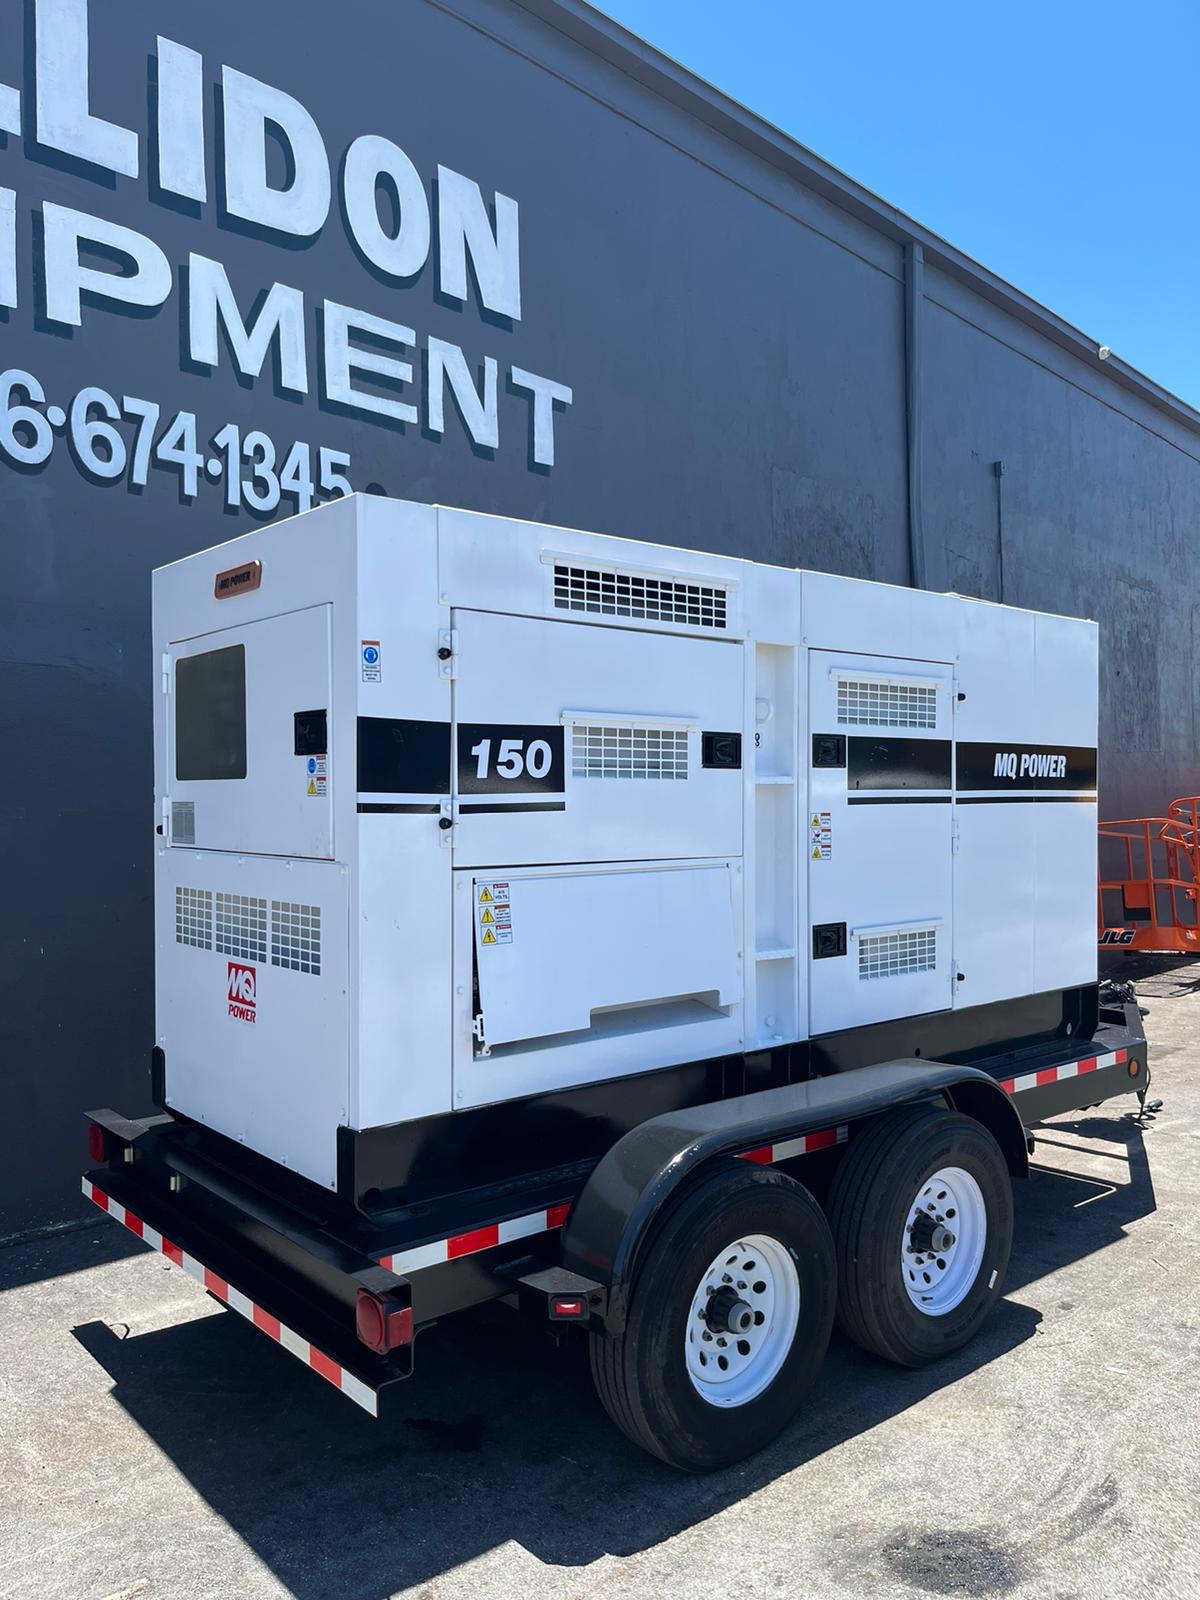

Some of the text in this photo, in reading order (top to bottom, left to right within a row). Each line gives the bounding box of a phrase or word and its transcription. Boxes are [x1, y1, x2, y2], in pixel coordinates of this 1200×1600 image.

[471, 739, 552, 779] 150
[993, 753, 1067, 780] MQ POWER
[1097, 930, 1136, 945] JLG
[228, 1004, 256, 1024] POWER
